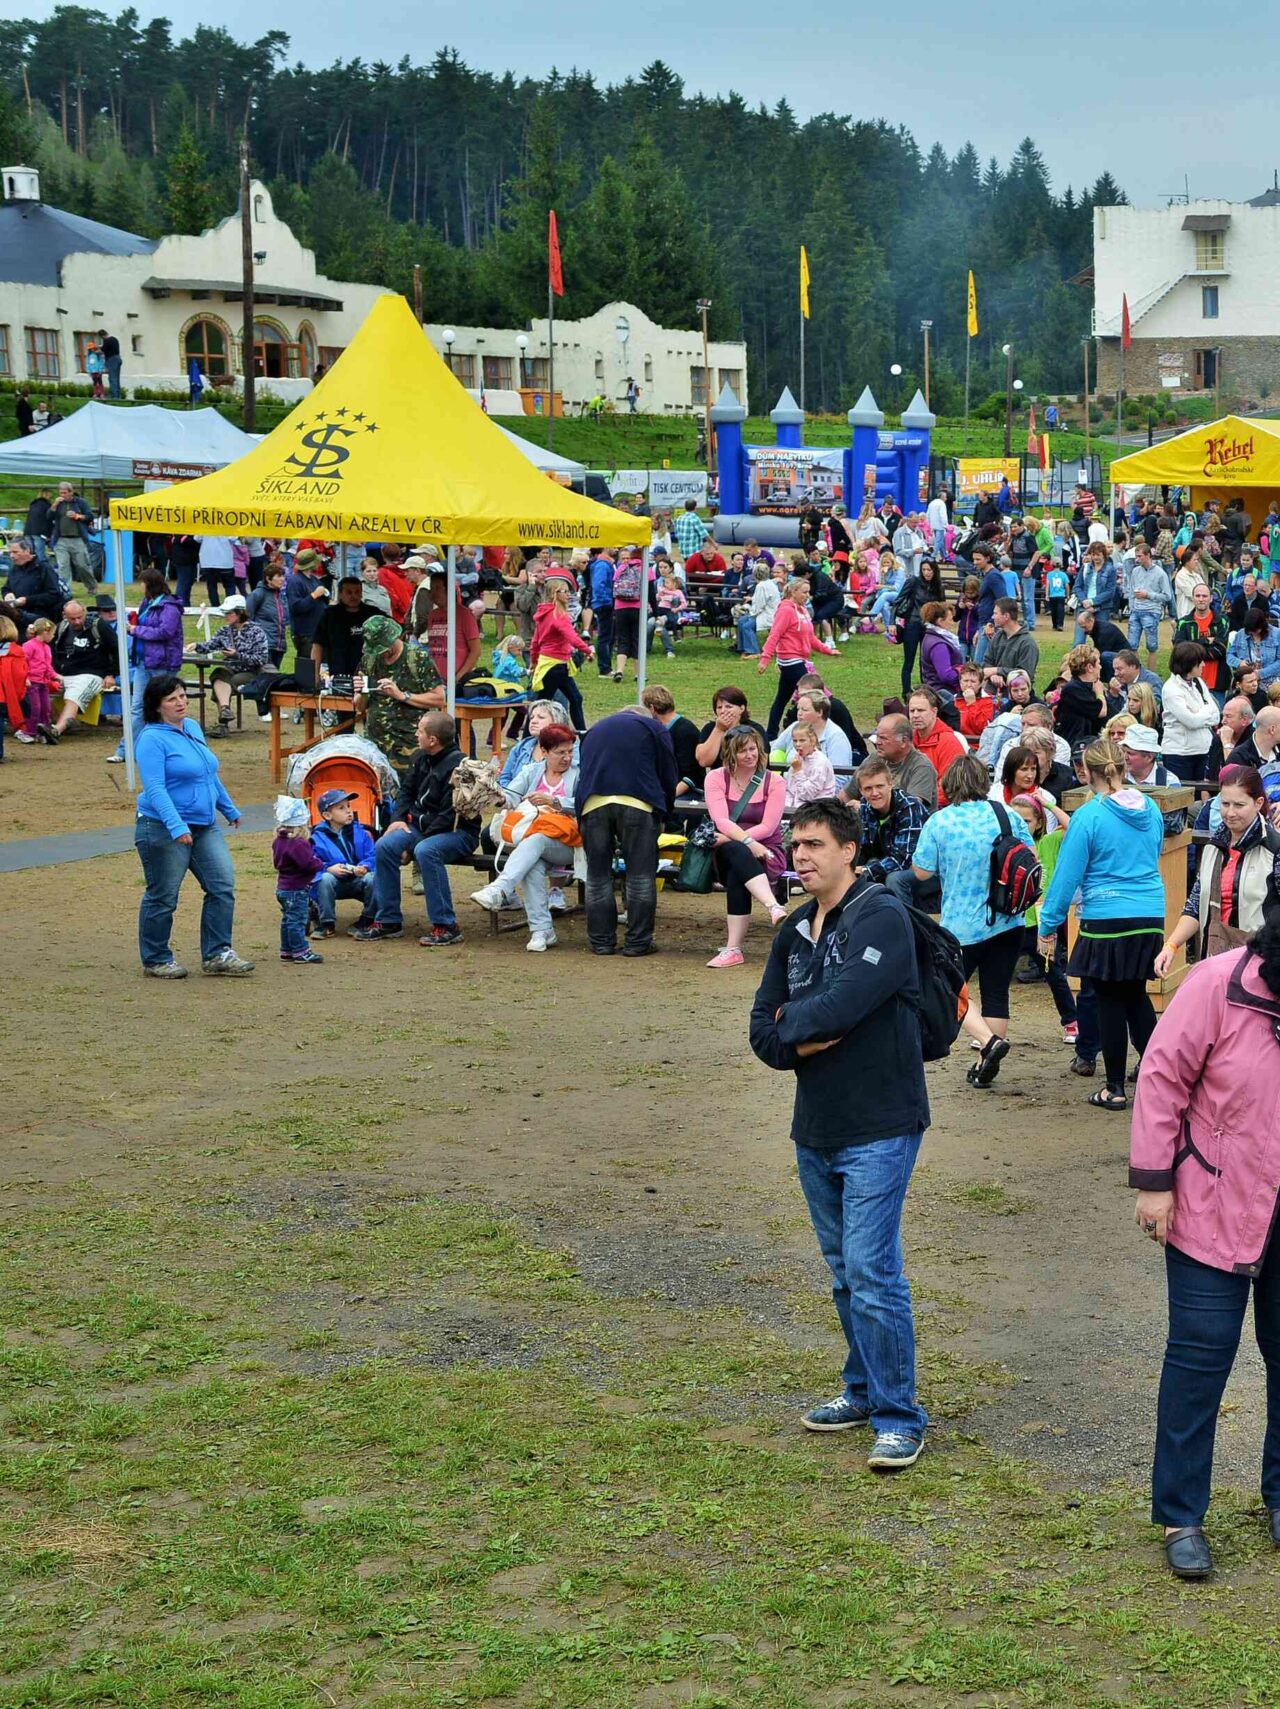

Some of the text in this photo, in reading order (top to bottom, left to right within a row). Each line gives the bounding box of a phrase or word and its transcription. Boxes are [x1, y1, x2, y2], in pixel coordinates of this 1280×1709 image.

[1203, 435, 1255, 470] Rebel
[256, 478, 341, 496] ŠIKLAND
[653, 482, 704, 495] TISK CENTRUM
[117, 505, 443, 534] NEJVĚTŠÍ PŘÍRODNÍ ZÁBAVNÍ AREÁL V ČR
[518, 519, 600, 539] www.sikland.cz
